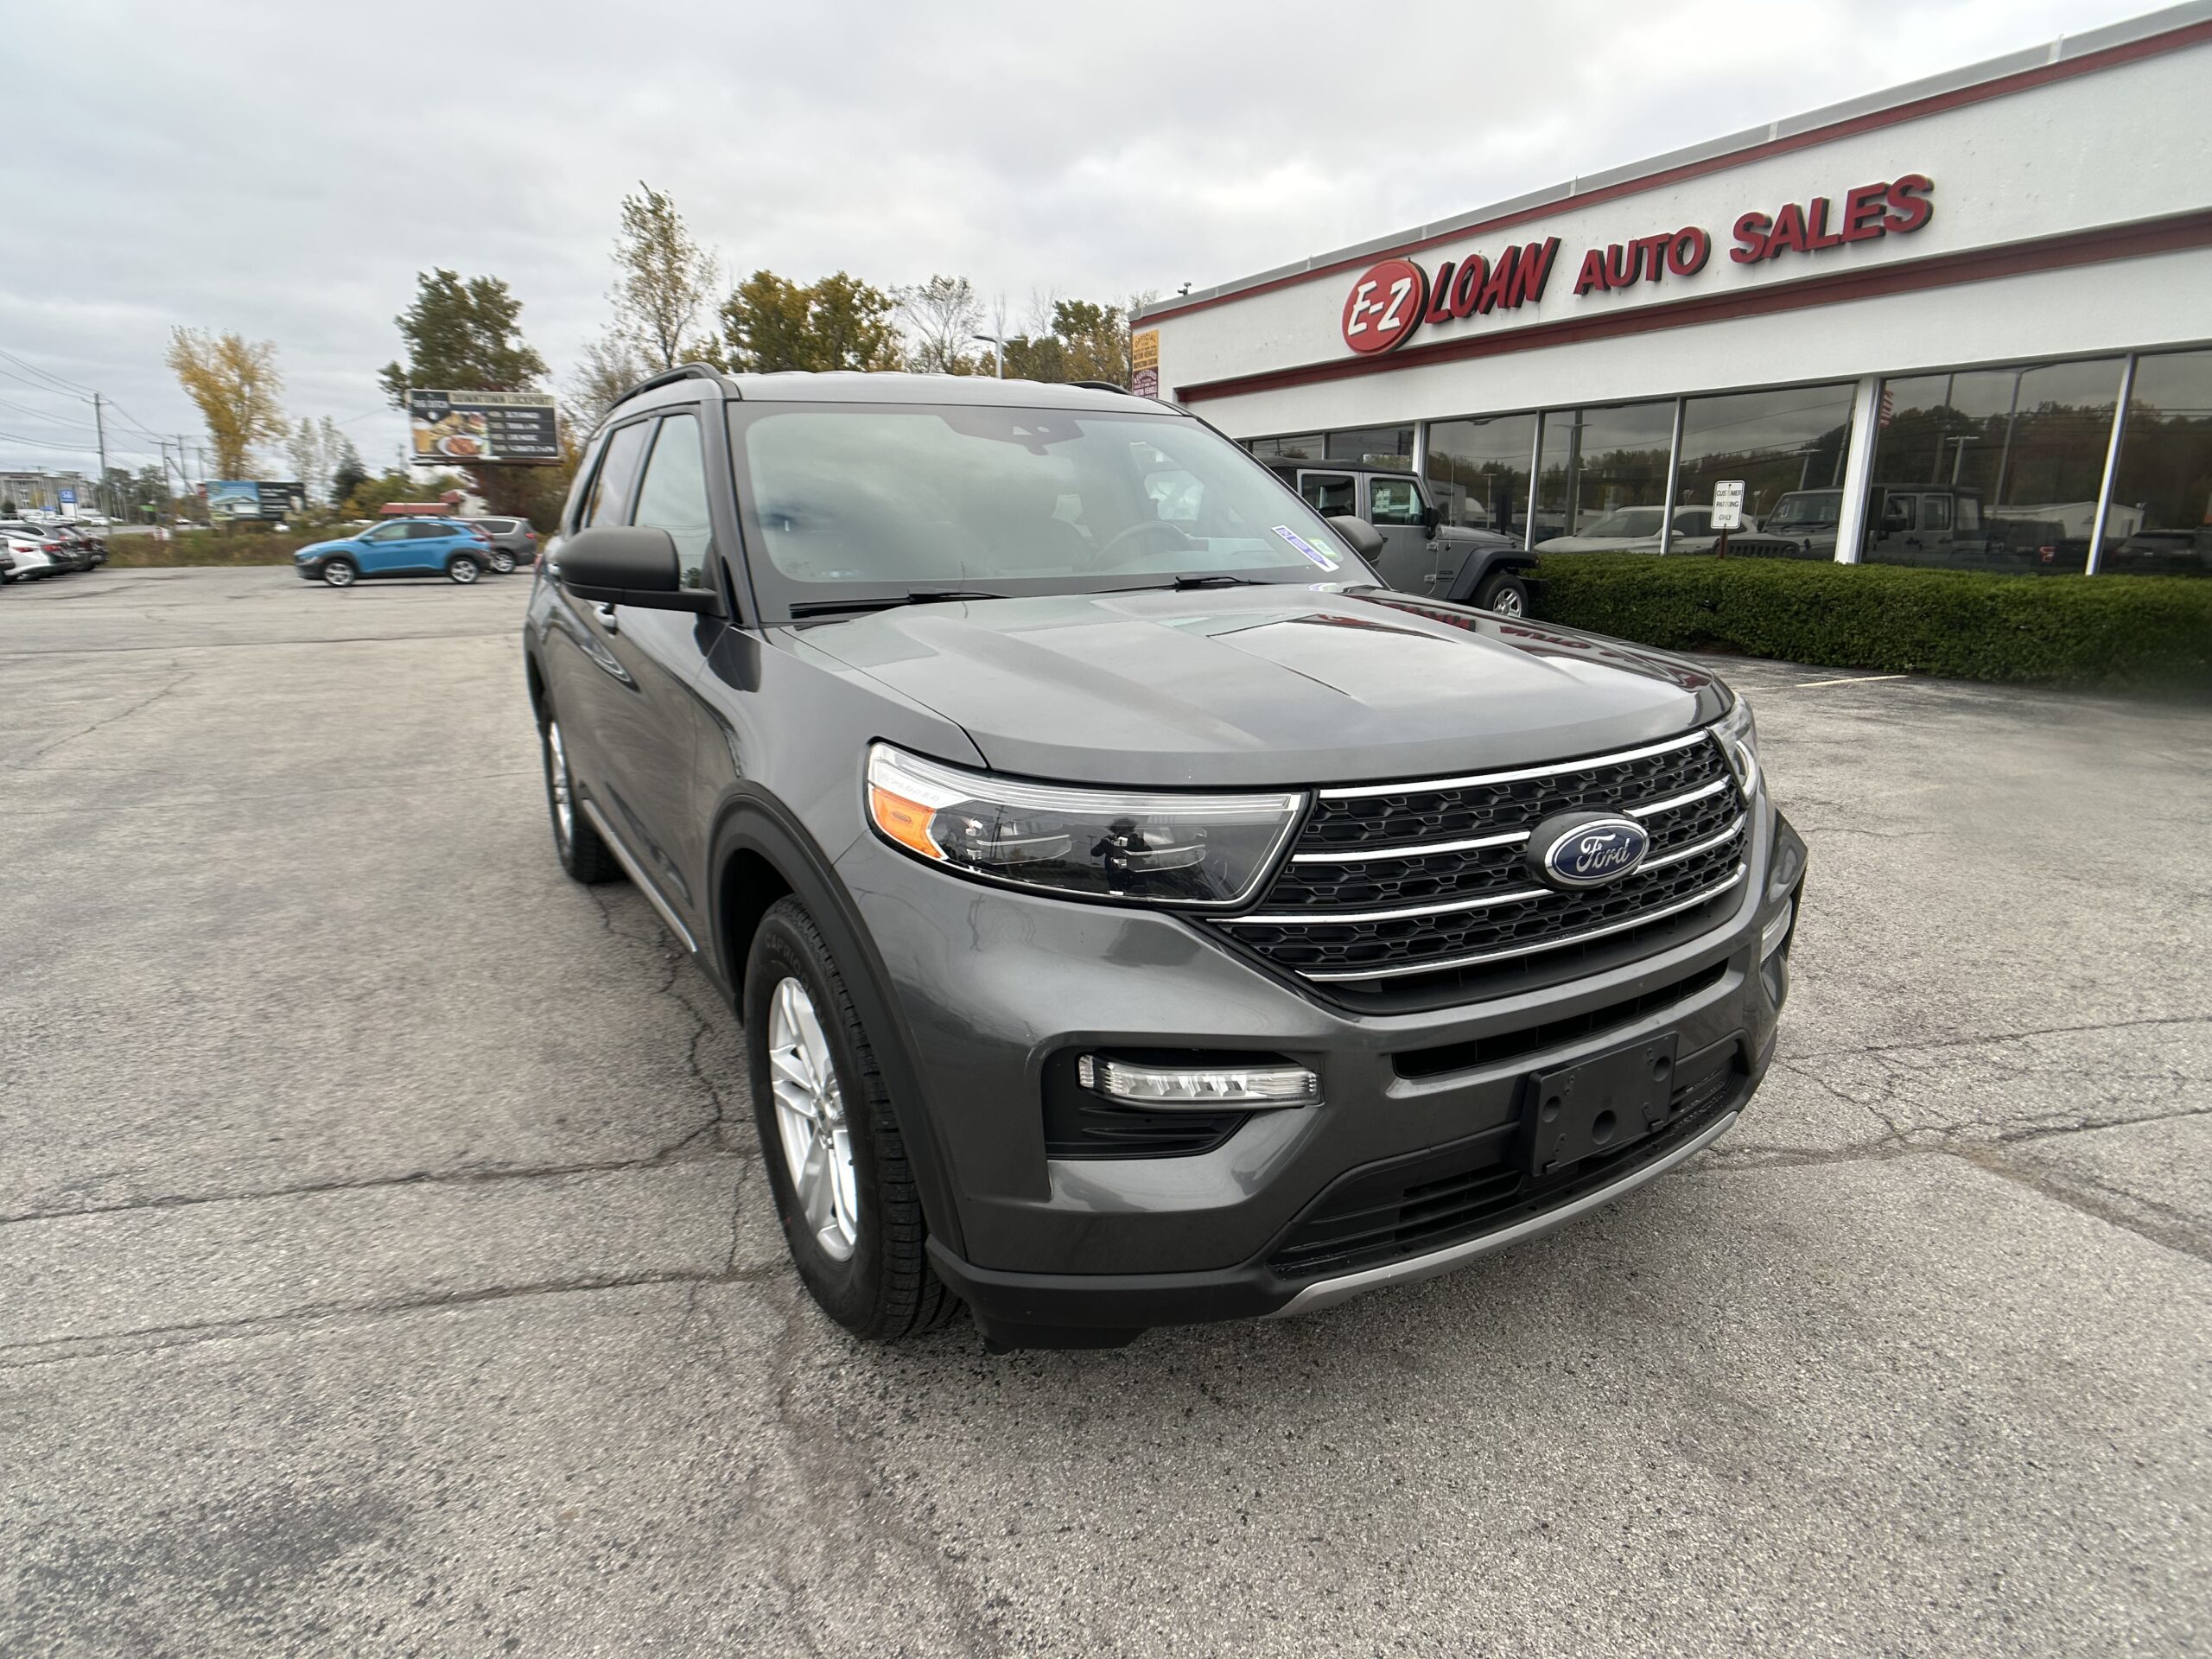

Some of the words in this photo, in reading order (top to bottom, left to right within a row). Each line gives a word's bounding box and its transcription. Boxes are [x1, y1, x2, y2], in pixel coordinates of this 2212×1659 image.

[1347, 276, 1413, 336] E-Z
[1424, 236, 1561, 325] LOAN
[1573, 226, 1712, 296] AUTO
[1729, 174, 1935, 264] SALES
[1135, 334, 1156, 347] OFFICIAL
[1134, 369, 1157, 384] REGISTERED
[1575, 832, 1631, 873] Ford
